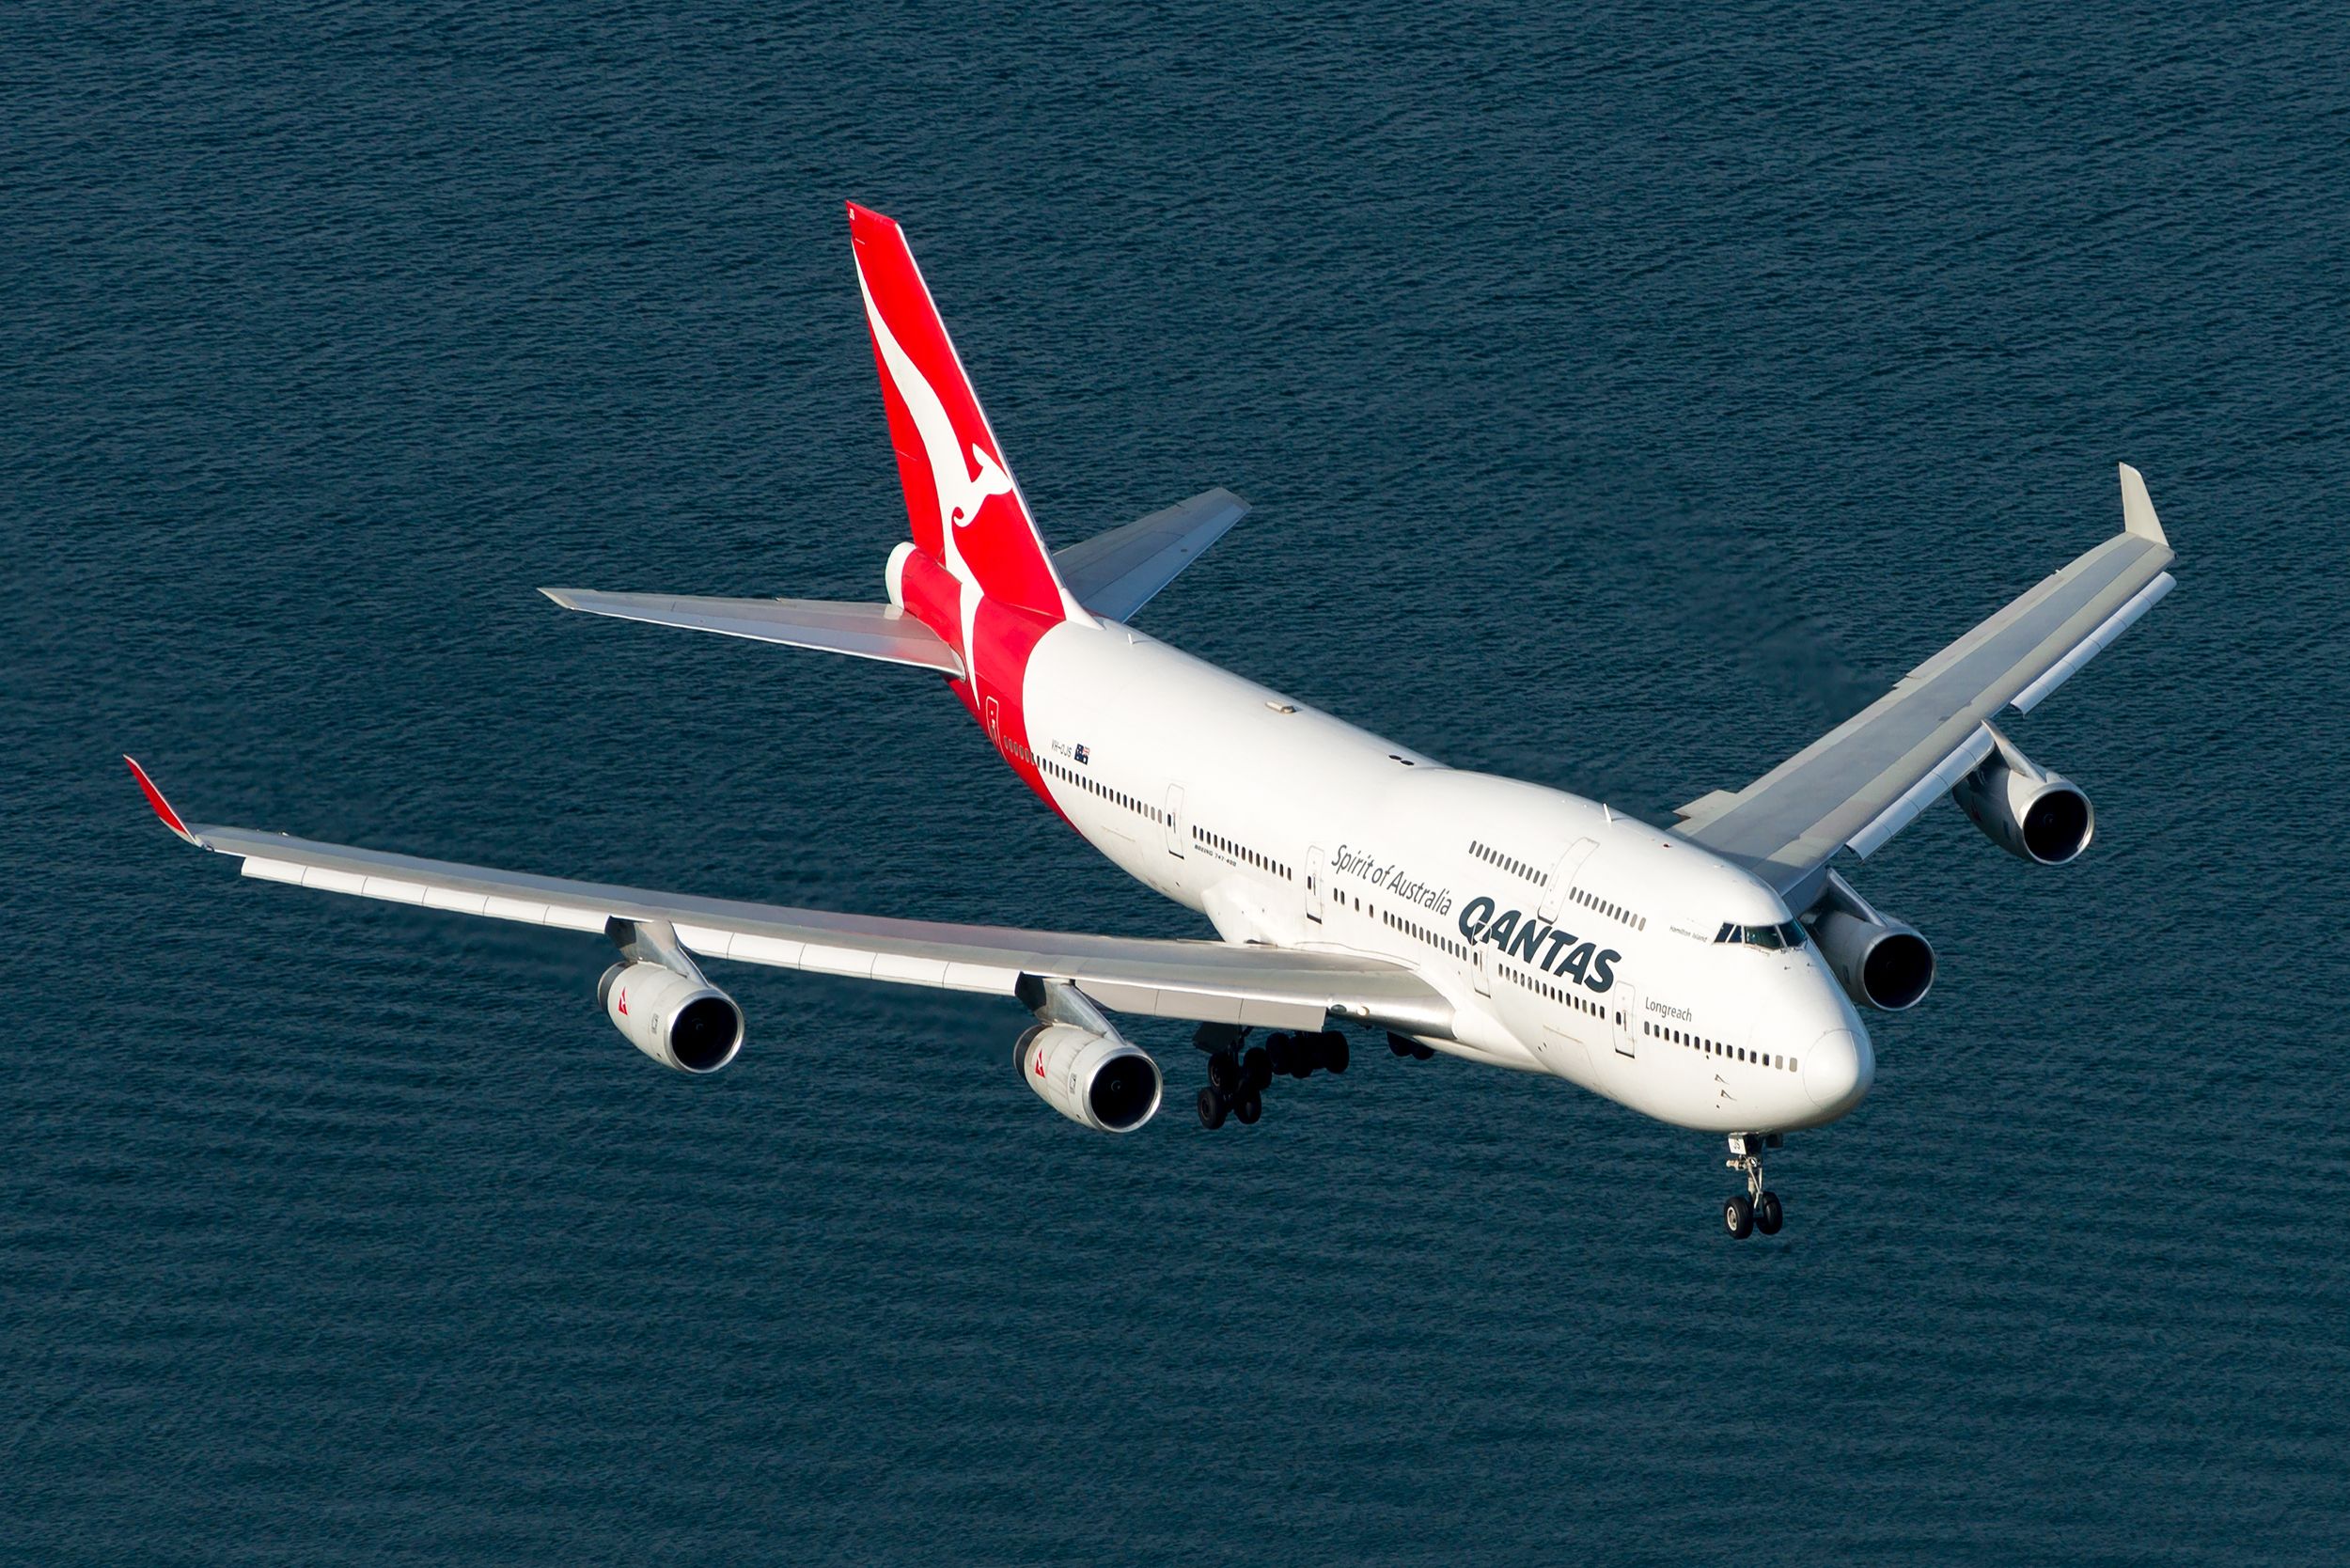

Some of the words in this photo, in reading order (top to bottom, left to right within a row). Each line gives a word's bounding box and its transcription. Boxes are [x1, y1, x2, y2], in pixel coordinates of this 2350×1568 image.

[1331, 844, 1374, 880] Spirit
[1371, 865, 1396, 886] of
[1386, 870, 1452, 916] Australia
[1459, 896, 1622, 993] QANTAS
[1645, 996, 1692, 1022] Longreach
